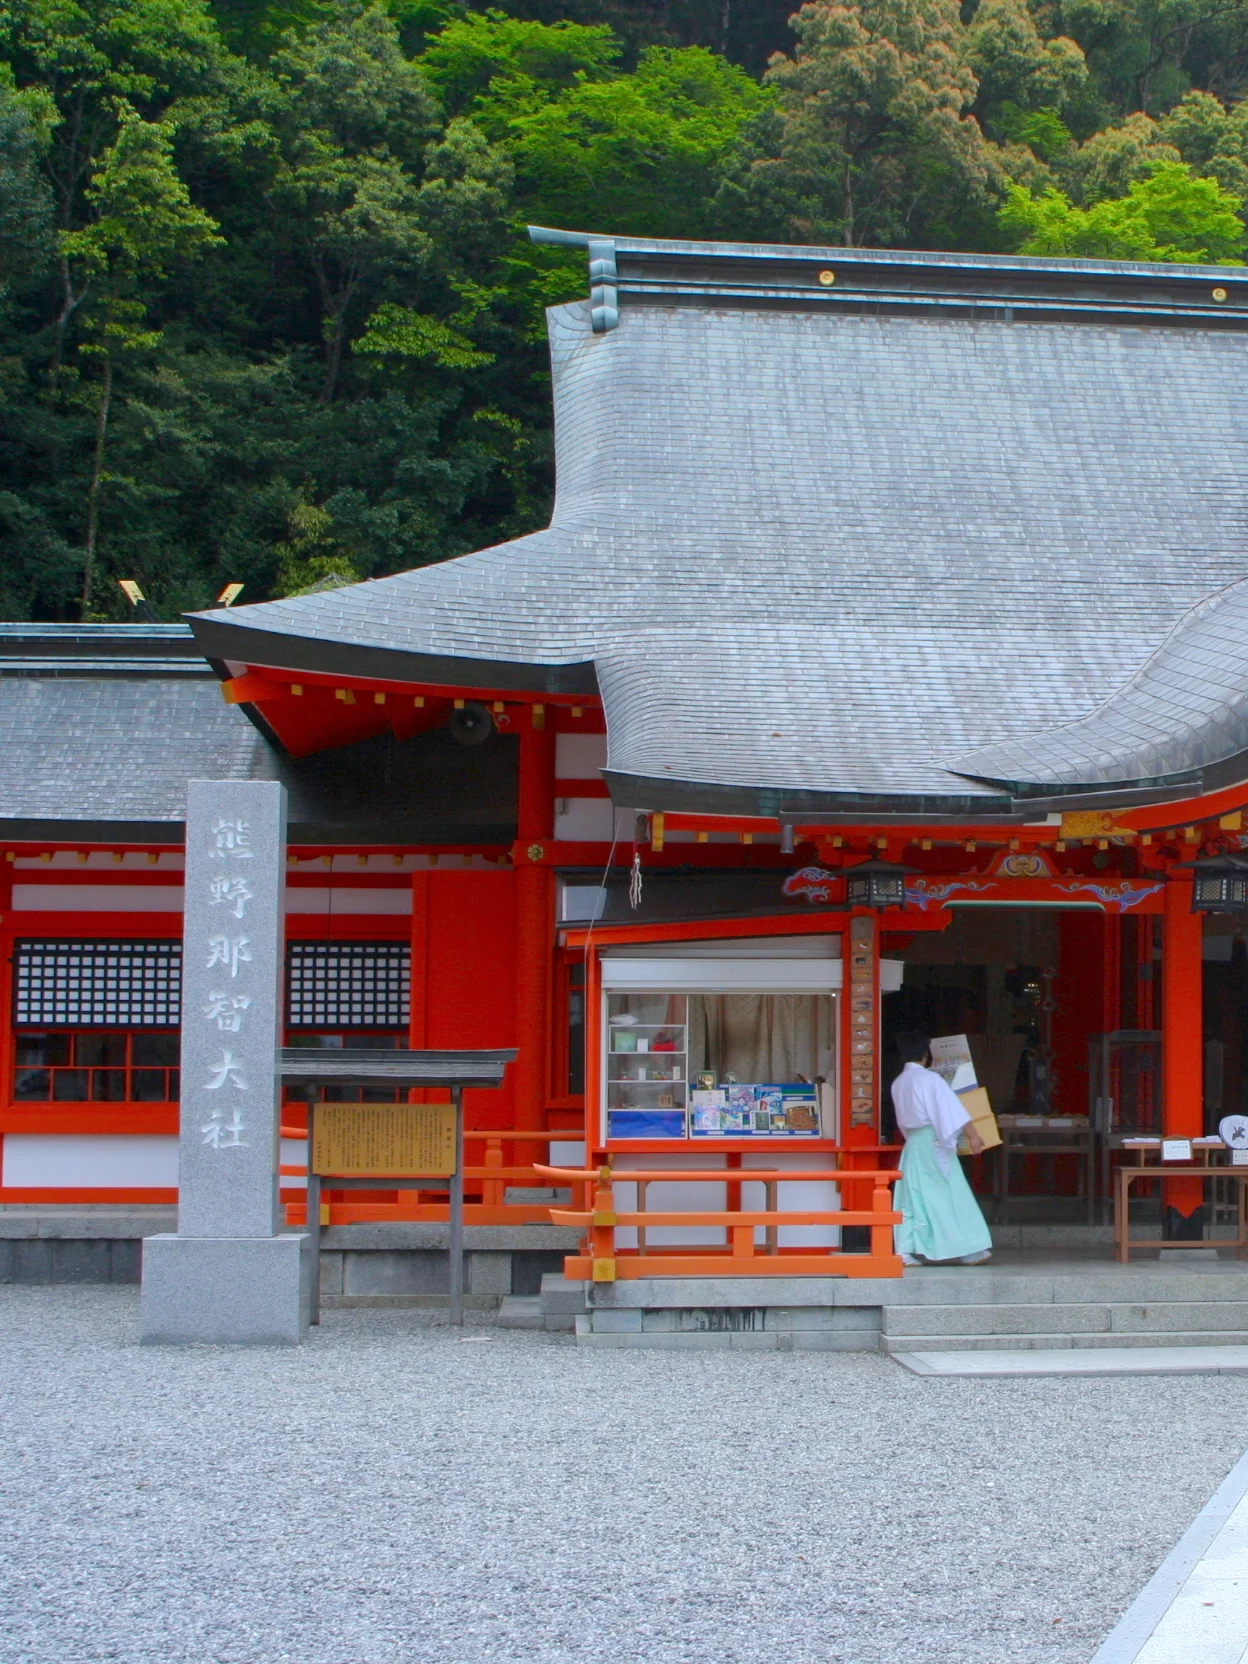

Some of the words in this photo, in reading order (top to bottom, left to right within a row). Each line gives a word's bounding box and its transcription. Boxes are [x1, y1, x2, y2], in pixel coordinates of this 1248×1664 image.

[201, 817, 255, 1149] 熊野那智大社
